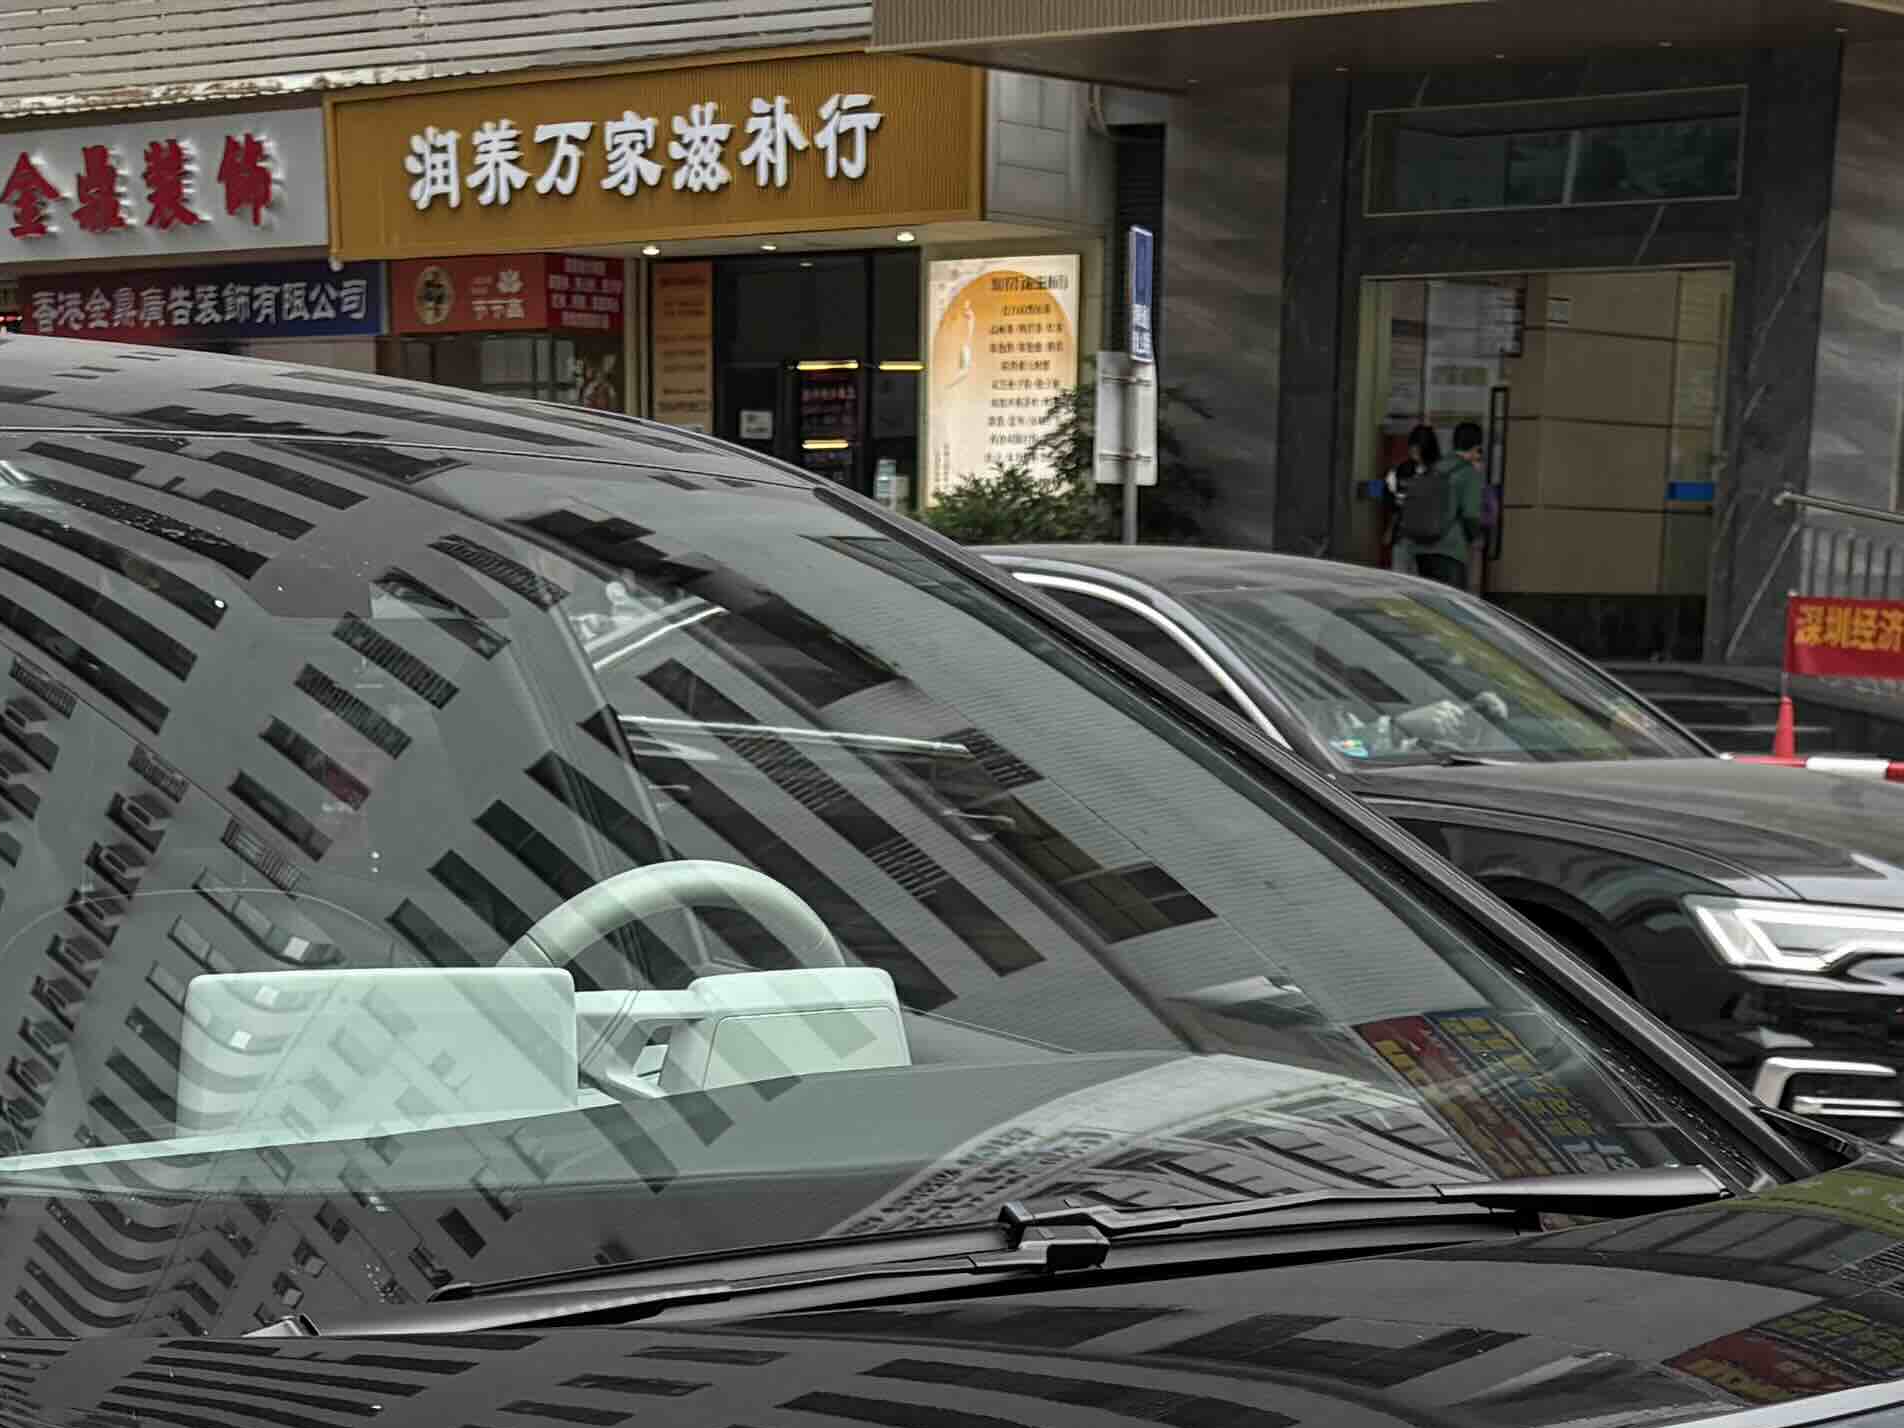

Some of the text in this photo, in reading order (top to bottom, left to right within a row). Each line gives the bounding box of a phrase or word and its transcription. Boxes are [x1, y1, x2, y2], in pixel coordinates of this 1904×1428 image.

[404, 94, 883, 210] 润养万家滋补行
